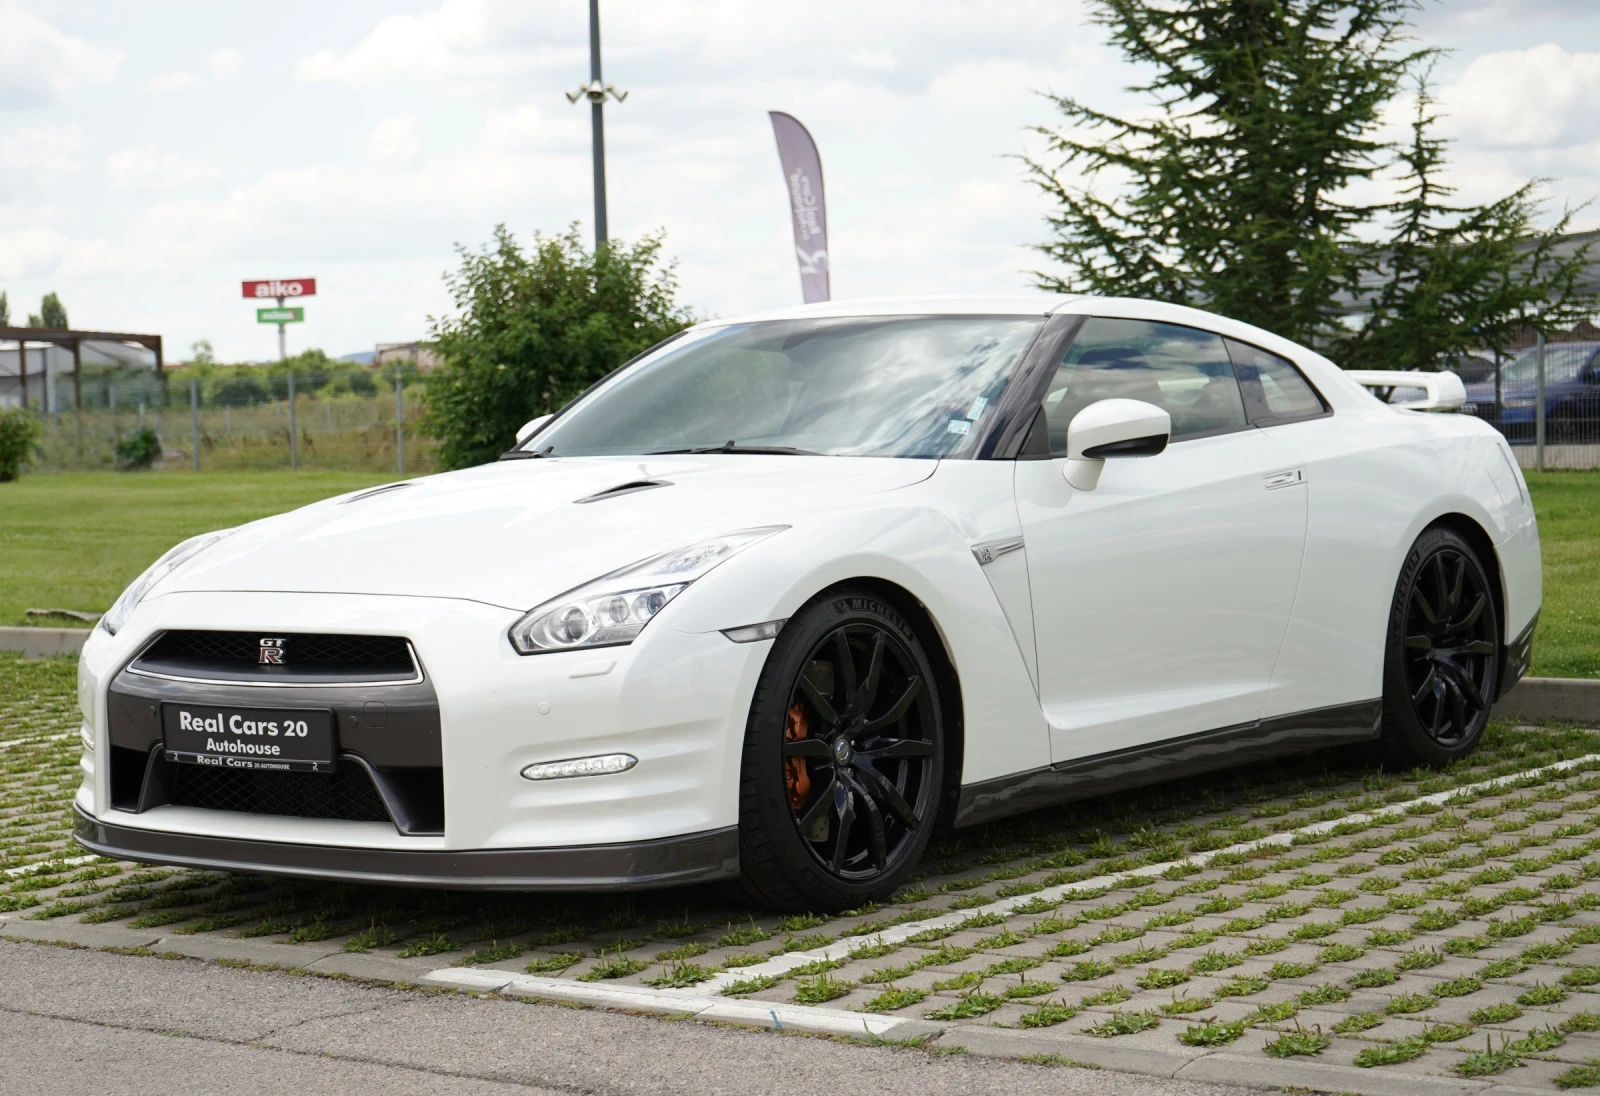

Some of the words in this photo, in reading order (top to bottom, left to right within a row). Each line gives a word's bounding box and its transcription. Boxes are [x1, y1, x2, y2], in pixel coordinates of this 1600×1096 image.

[255, 281, 303, 297] aiko
[851, 599, 913, 636] MICHELIN
[260, 638, 286, 647] GT
[258, 647, 284, 664] R
[179, 711, 224, 733] Real
[229, 715, 279, 736] Cars
[283, 720, 308, 738] 20
[206, 738, 281, 756] Autohouse
[198, 755, 222, 766] Real
[226, 758, 253, 768] Cars
